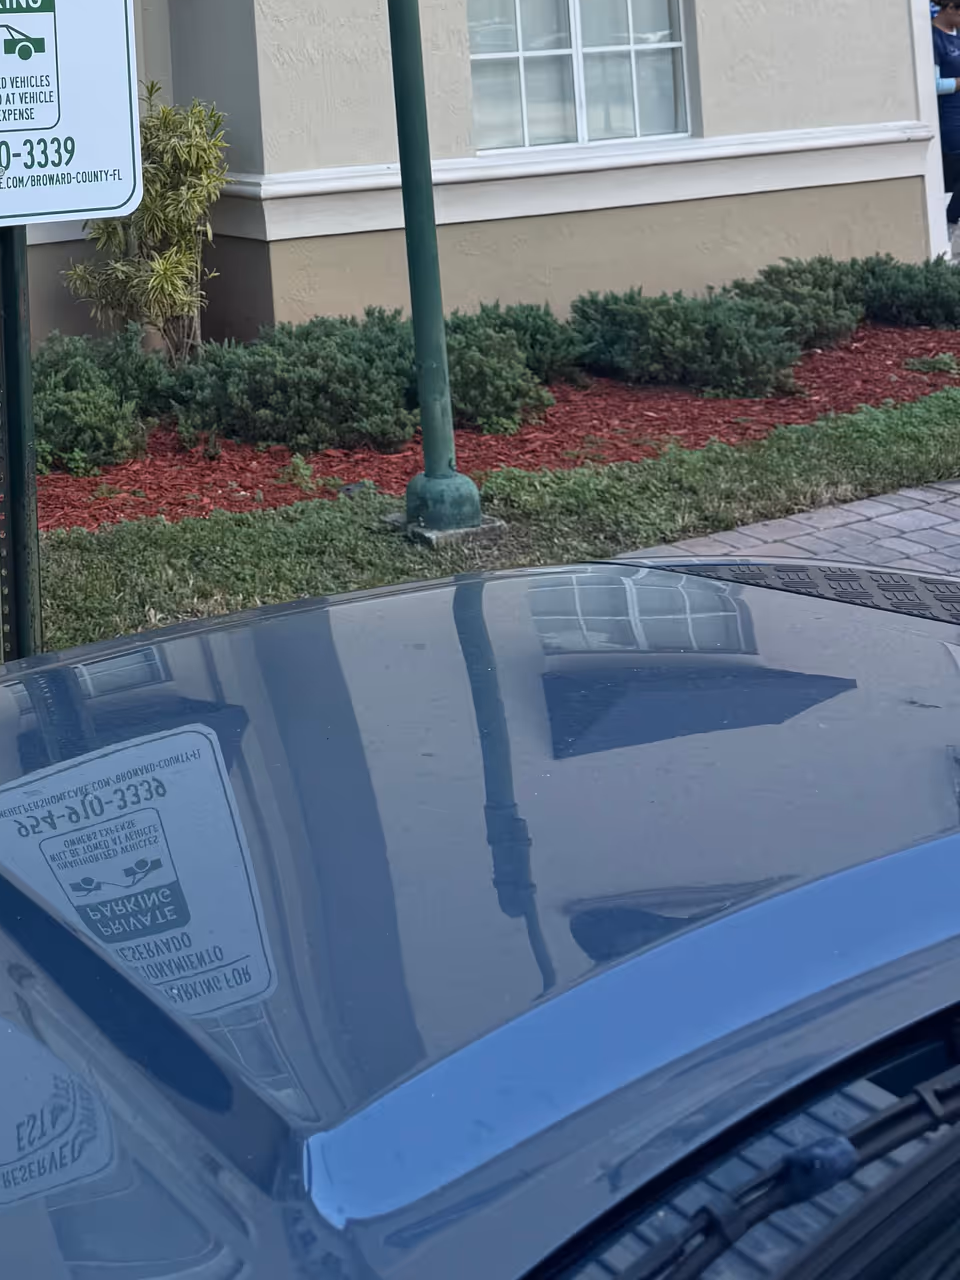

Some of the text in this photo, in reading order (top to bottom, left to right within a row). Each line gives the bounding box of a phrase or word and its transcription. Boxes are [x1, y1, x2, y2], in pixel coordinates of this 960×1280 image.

[9, 74, 51, 89] VEHICLES
[5, 92, 16, 105] AT
[18, 90, 54, 104] VEHICLE
